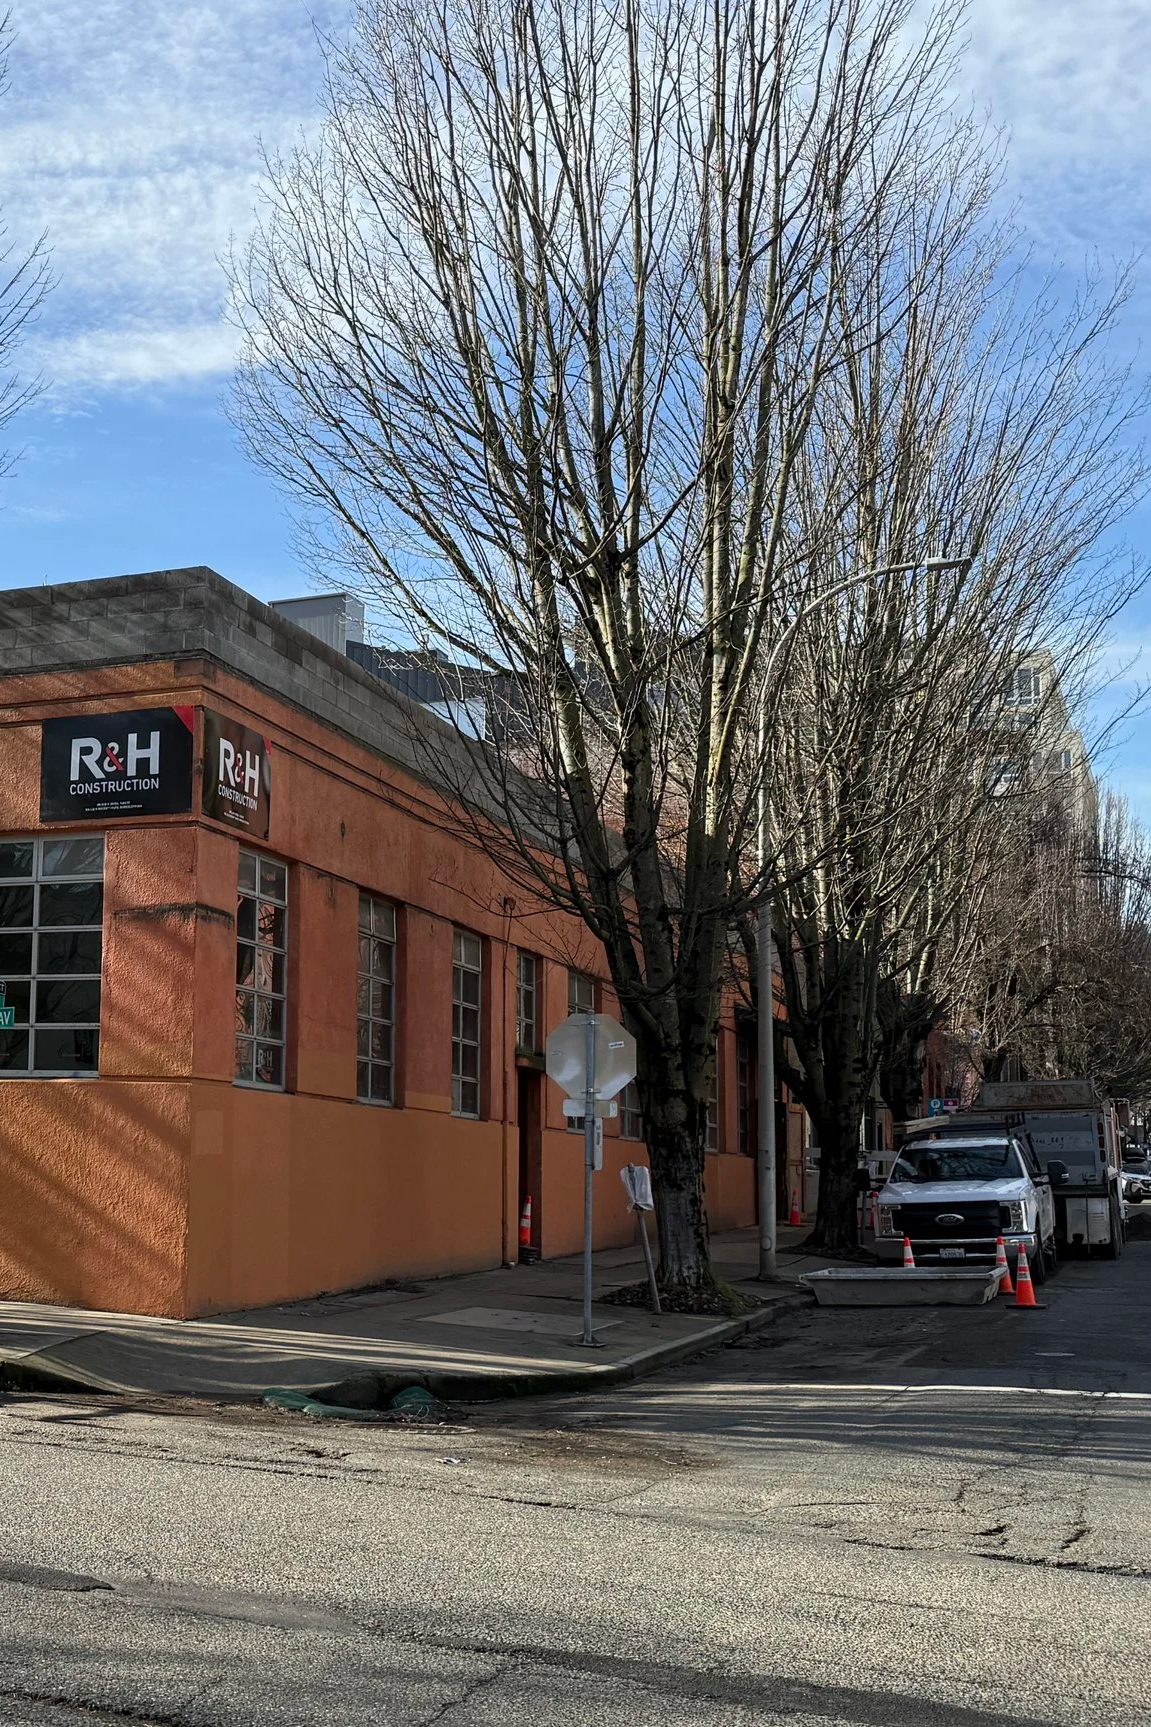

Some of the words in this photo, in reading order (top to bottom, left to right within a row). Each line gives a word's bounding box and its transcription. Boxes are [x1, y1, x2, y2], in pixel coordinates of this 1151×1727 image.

[70, 731, 160, 781] R&H
[218, 737, 260, 797] R&H
[69, 778, 159, 795] CONSTRUCTION
[218, 784, 258, 811] CONSTRUCTION
